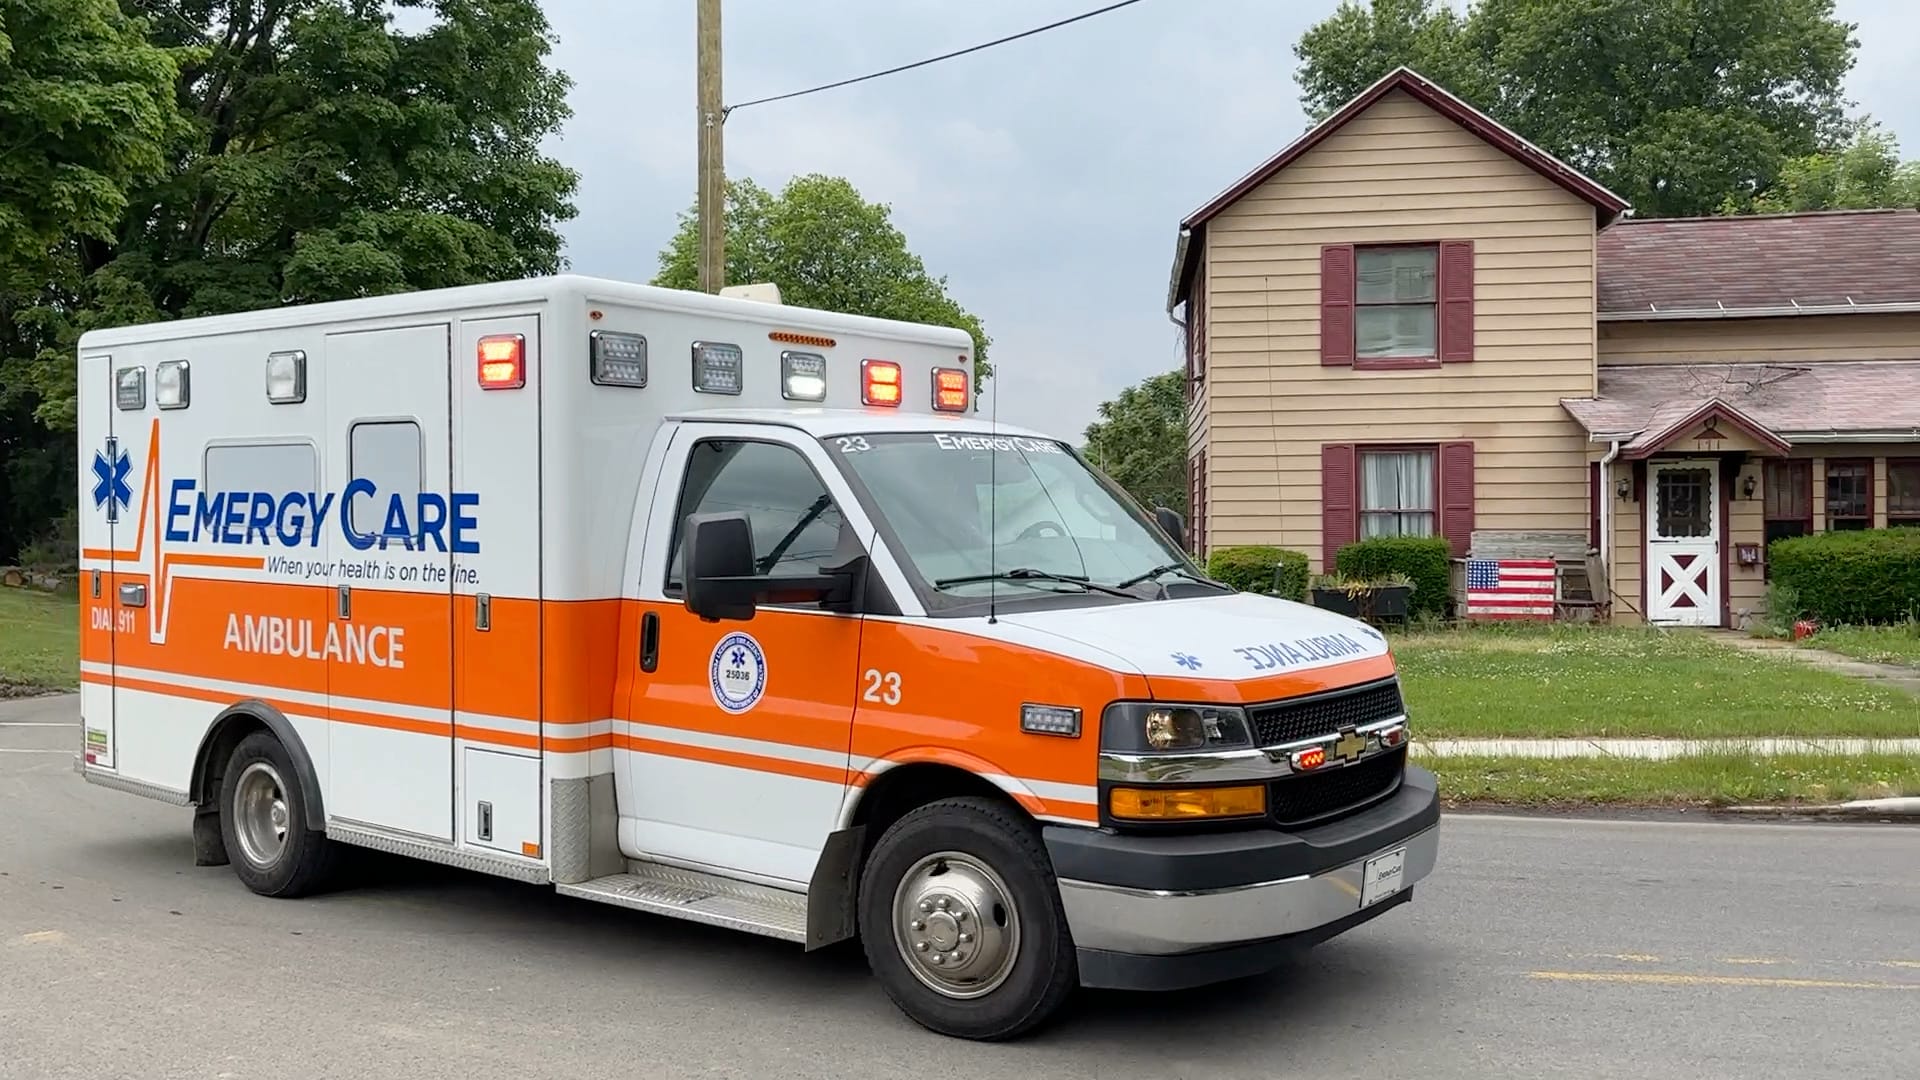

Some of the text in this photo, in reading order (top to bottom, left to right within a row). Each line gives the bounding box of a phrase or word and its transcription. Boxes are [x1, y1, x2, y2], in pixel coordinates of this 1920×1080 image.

[835, 435, 871, 454] 23
[268, 555, 481, 585] When your health is on the line.
[91, 606, 136, 635] DIAL 911
[223, 612, 405, 669] AMBULANCE
[863, 668, 902, 706] 23
